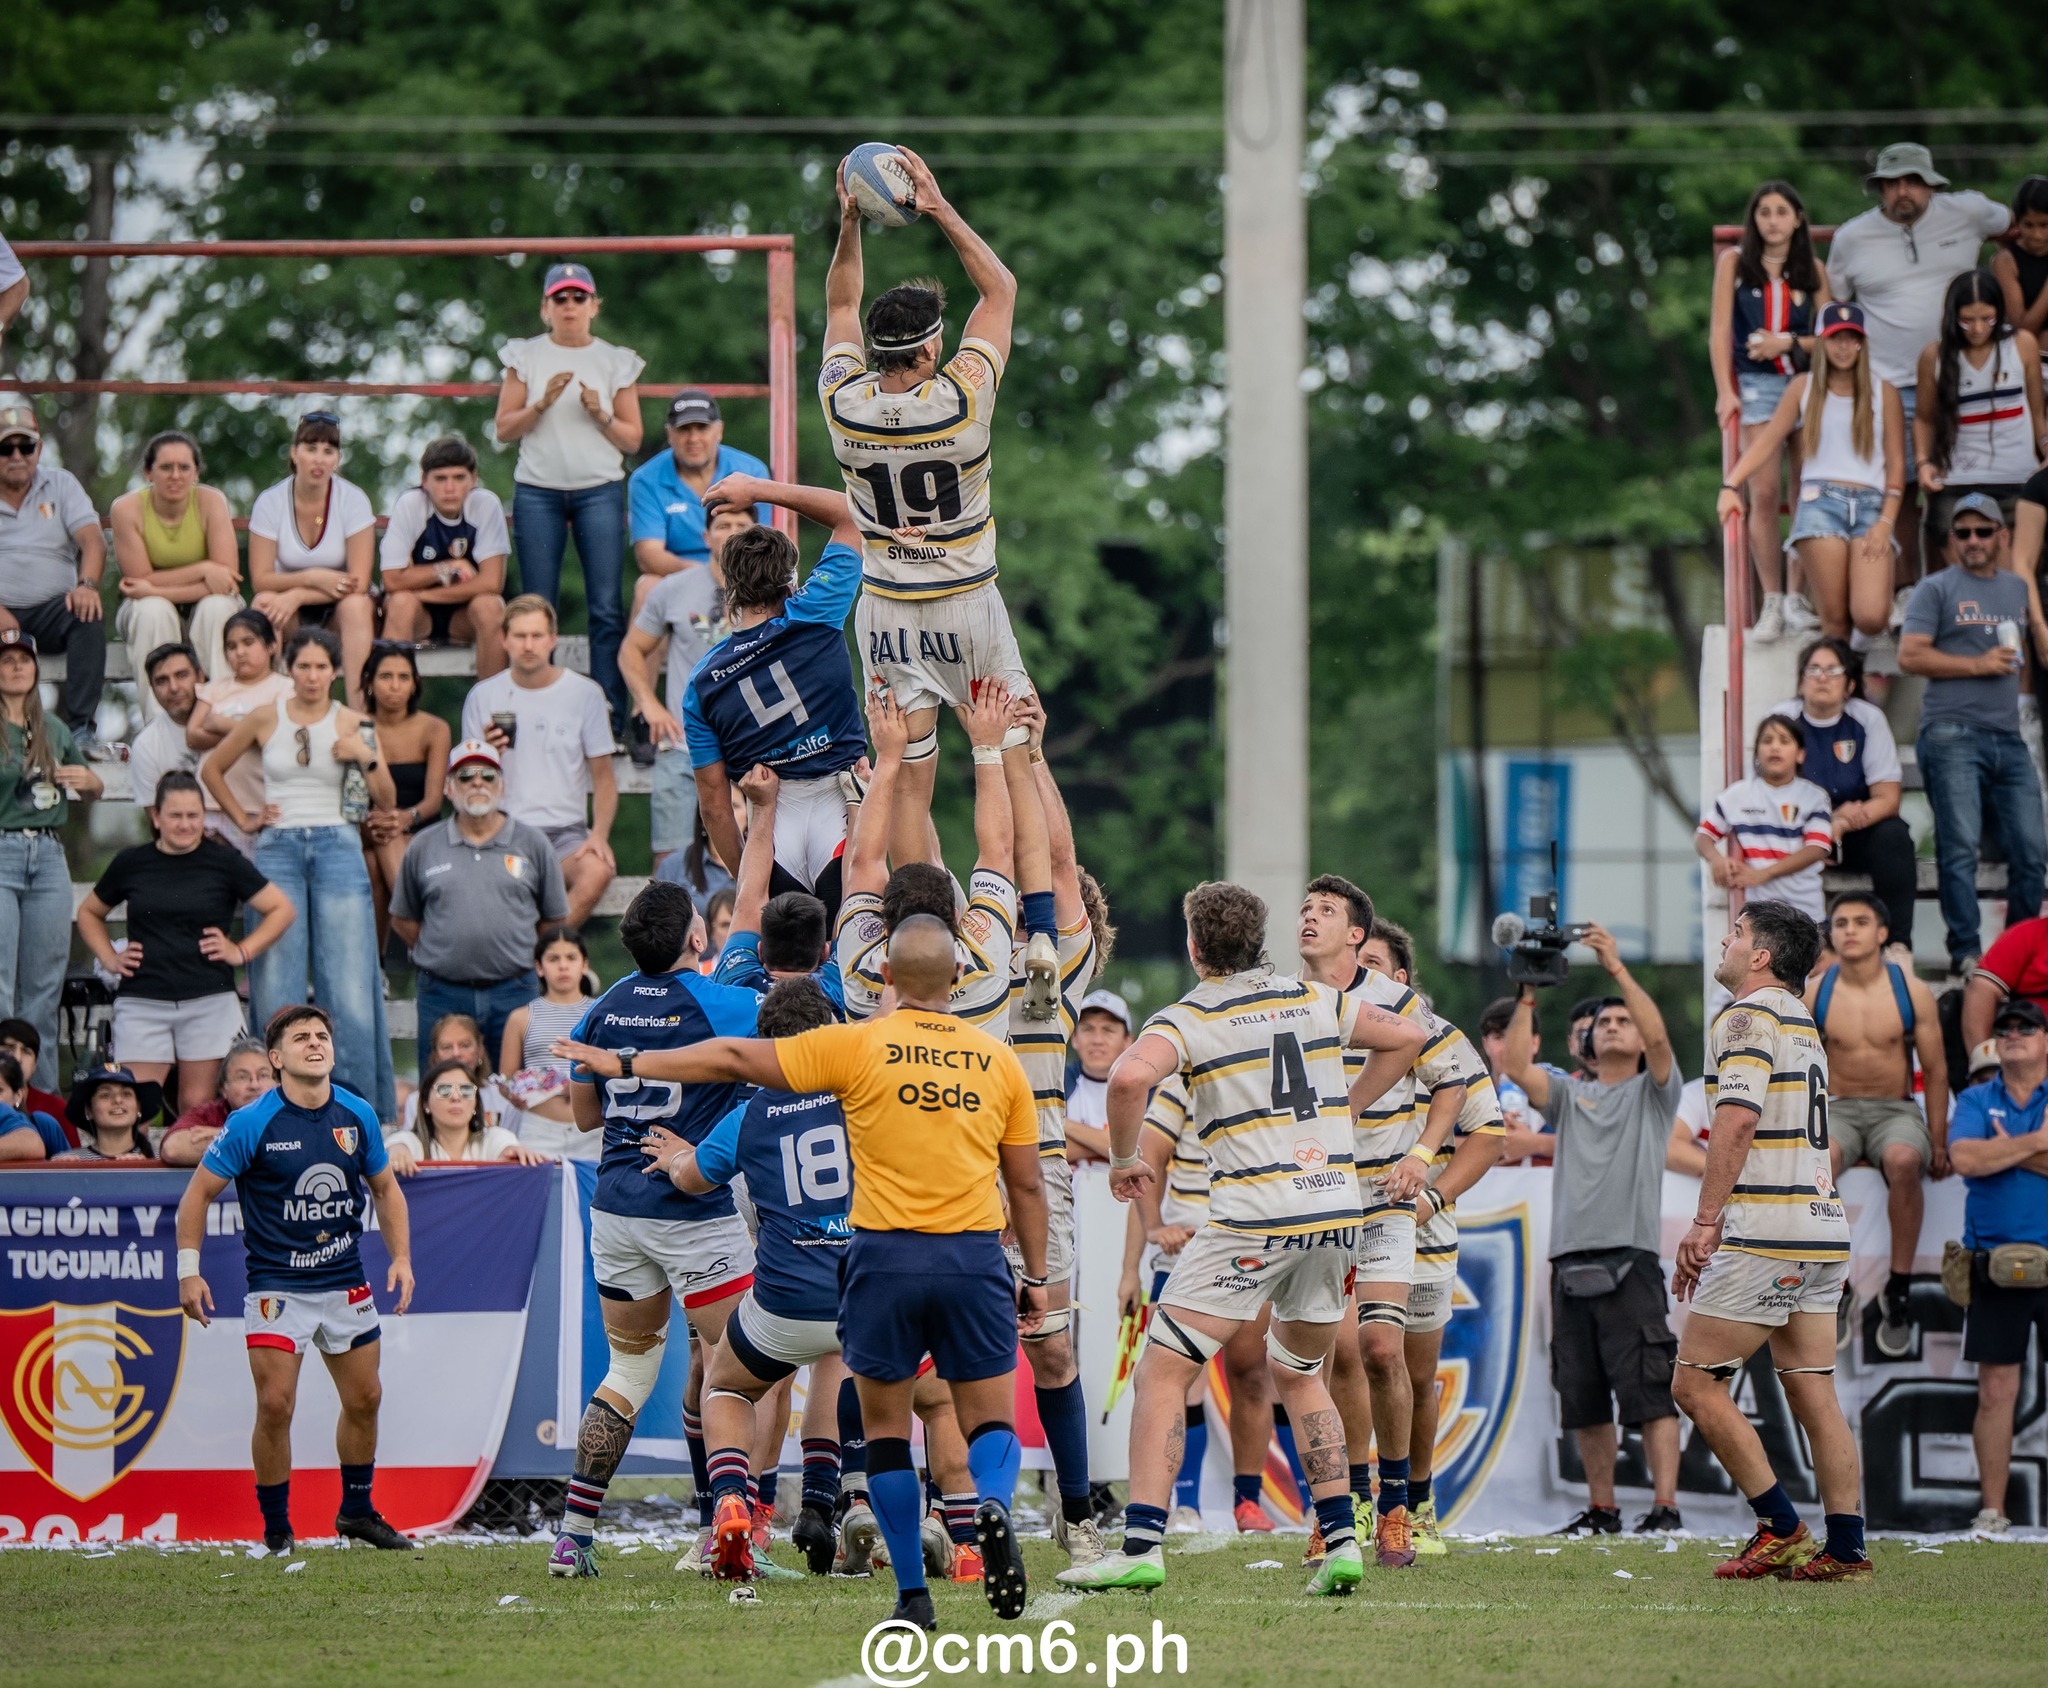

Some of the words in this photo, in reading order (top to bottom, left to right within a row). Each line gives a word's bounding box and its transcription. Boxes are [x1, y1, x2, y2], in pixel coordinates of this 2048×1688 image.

[843, 438, 889, 451] STELLA
[904, 437, 956, 451] ARTOIS
[853, 460, 962, 529] 19
[888, 545, 947, 561] SYNBUILD
[738, 660, 809, 728] 4
[796, 734, 830, 755] Alfa
[633, 986, 668, 997] PROCER
[1229, 1014, 1268, 1027] STELLA
[1792, 1037, 1812, 1048] STELLA
[885, 1043, 992, 1073] DIRECTV
[1270, 1031, 1319, 1122] 4
[1720, 1083, 1750, 1092] PAMPA
[1807, 1063, 1829, 1151] 6
[266, 1141, 301, 1152] PROCER
[779, 1124, 851, 1207] 18
[1292, 1170, 1345, 1191] SYNBUILD
[132, 1206, 162, 1237] Y
[7, 1242, 163, 1280] TUCUMÁN
